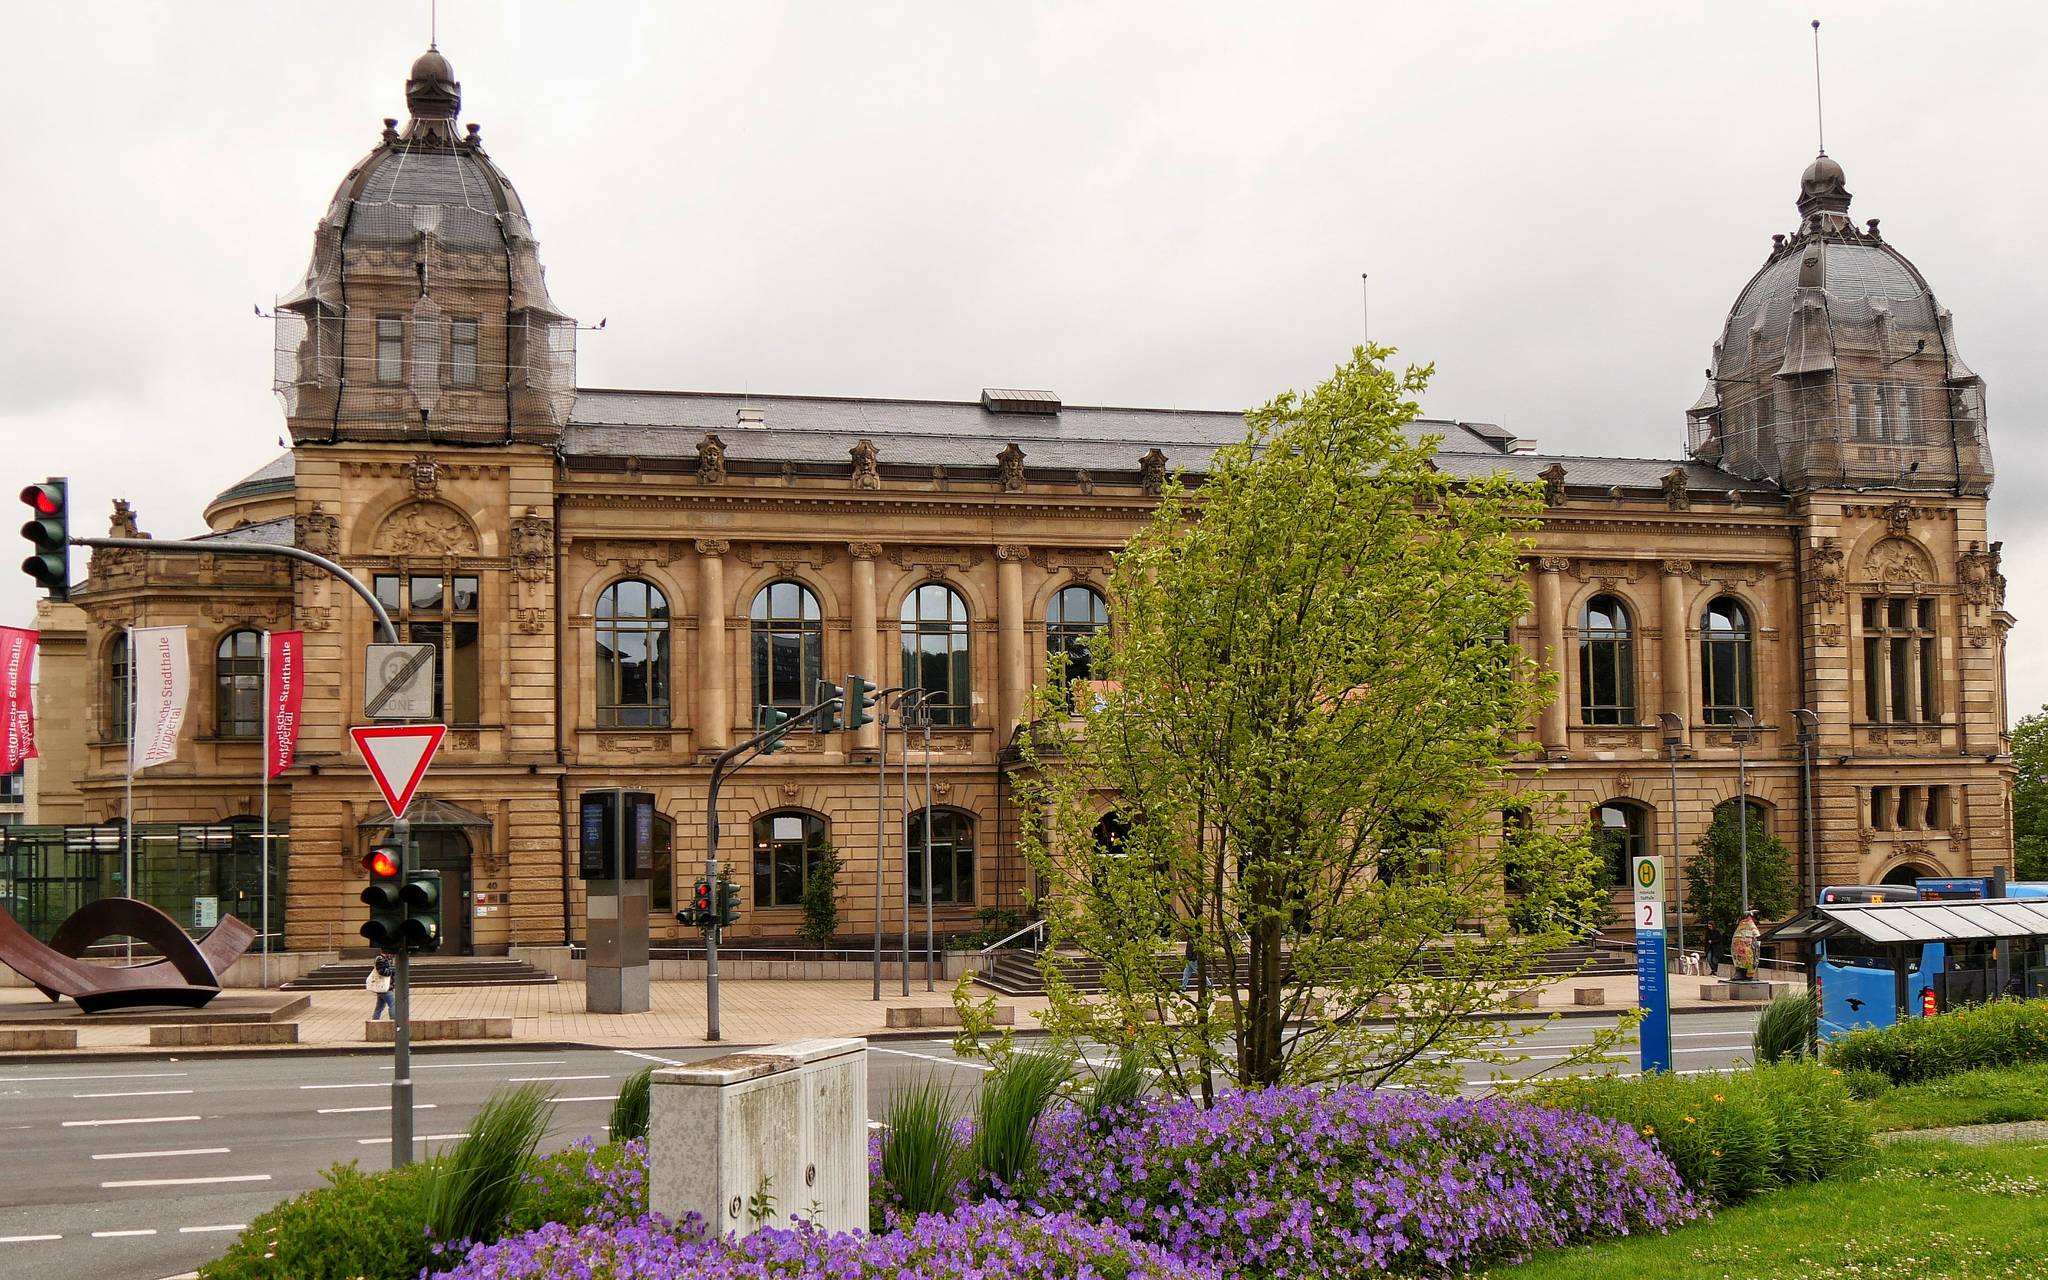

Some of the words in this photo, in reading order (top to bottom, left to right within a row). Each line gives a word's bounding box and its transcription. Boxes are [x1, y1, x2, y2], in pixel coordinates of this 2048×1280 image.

[8, 637, 23, 699] Stadthalle
[159, 636, 173, 697] Stadthalle
[279, 641, 292, 702] Stadthalle
[155, 707, 182, 761] Wuppertal
[1643, 905, 1653, 926] 2
